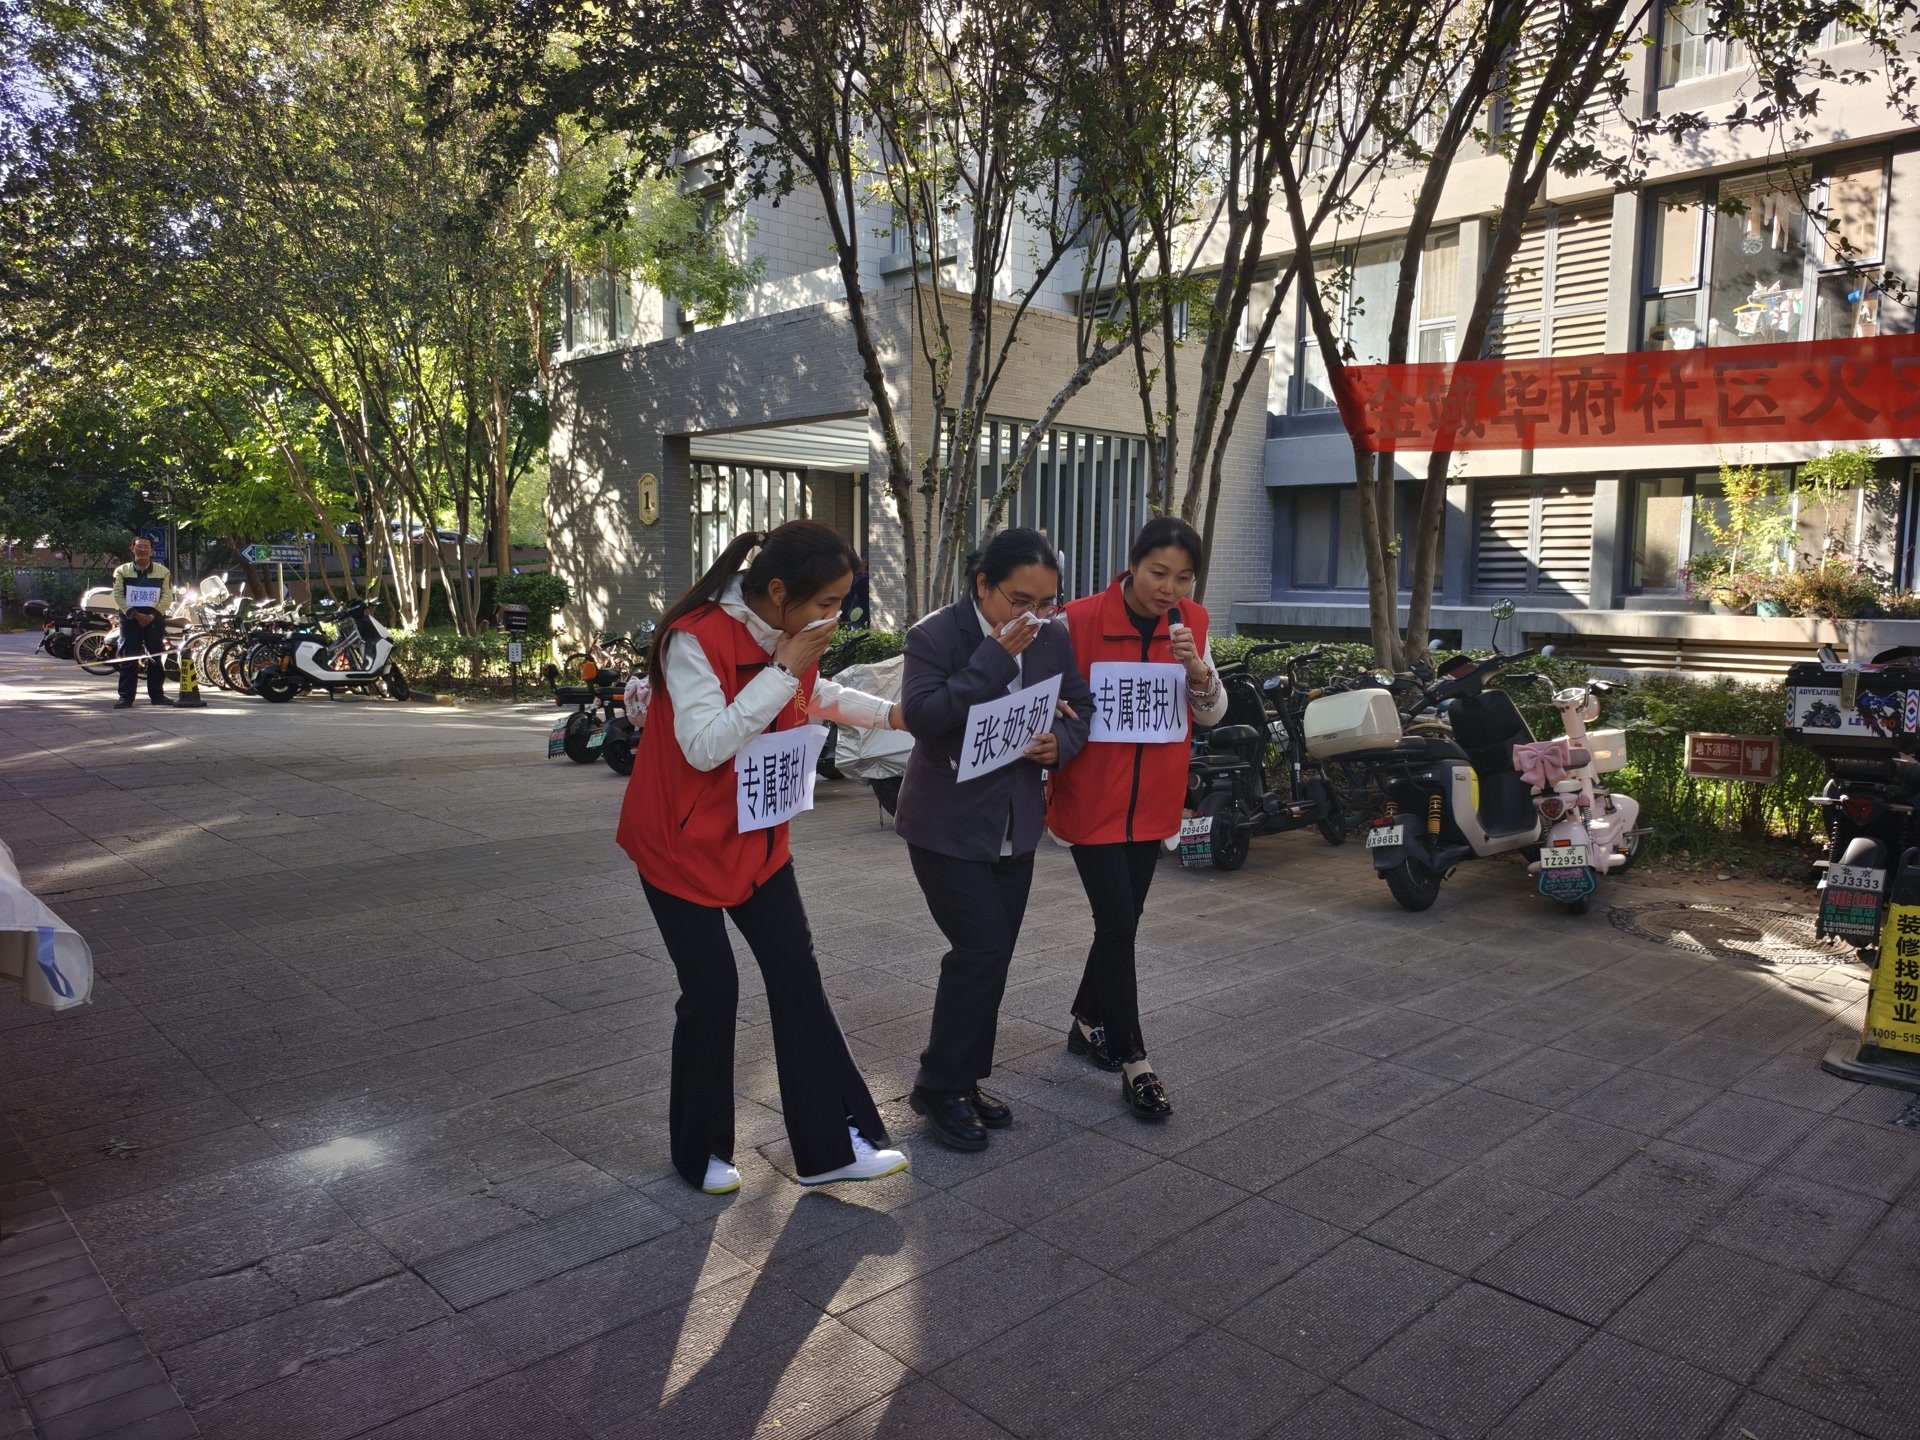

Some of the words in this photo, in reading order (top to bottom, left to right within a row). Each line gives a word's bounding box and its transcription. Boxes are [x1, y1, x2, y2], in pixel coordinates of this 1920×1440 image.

[131, 590, 157, 603] 保障组
[1098, 677, 1181, 732] 专属帮扶人
[971, 694, 1049, 768] 张奶奶
[1695, 742, 1739, 757] 地下消防栓
[742, 744, 806, 820] 专属帮扶人
[1182, 825, 1209, 835] PD9450
[1544, 856, 1583, 867] TZ2925
[1831, 875, 1879, 889] SJ3333
[1892, 914, 1920, 1024] 装修找物业
